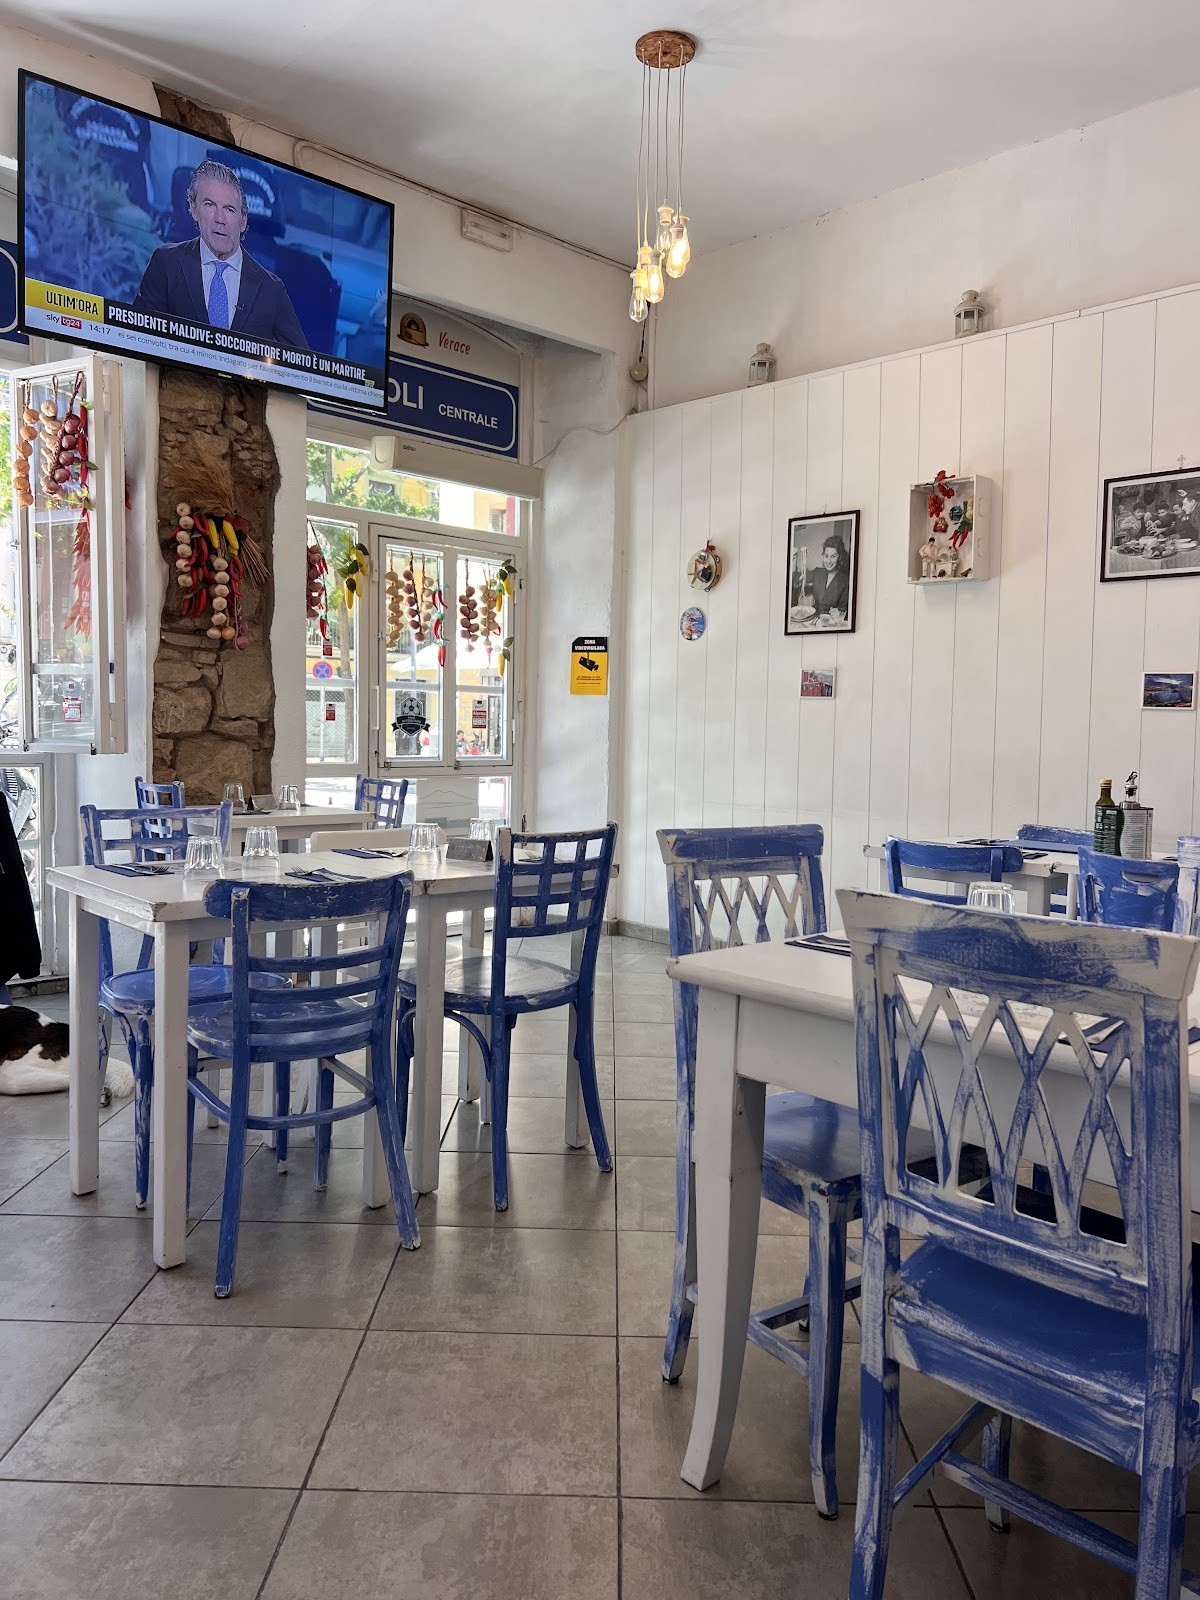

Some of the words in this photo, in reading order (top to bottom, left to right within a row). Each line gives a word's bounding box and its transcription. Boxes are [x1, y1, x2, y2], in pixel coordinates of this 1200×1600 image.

[46, 291, 99, 315] ULTIM'ORA
[46, 313, 60, 324] sky
[62, 316, 81, 328] tg24
[89, 324, 111, 335] 14:17
[168, 343, 179, 352] tra
[190, 348, 196, 356] 4
[108, 305, 168, 333] PRESIDENTE
[169, 321, 214, 345] MALDIVE:
[215, 332, 281, 360] SOCCORRITORE
[282, 349, 312, 367] MORTO
[312, 354, 318, 370] È
[319, 358, 331, 373] UN
[331, 361, 366, 380] MARTIRE
[438, 331, 471, 355] Verace
[438, 403, 499, 429] CENTRALE
